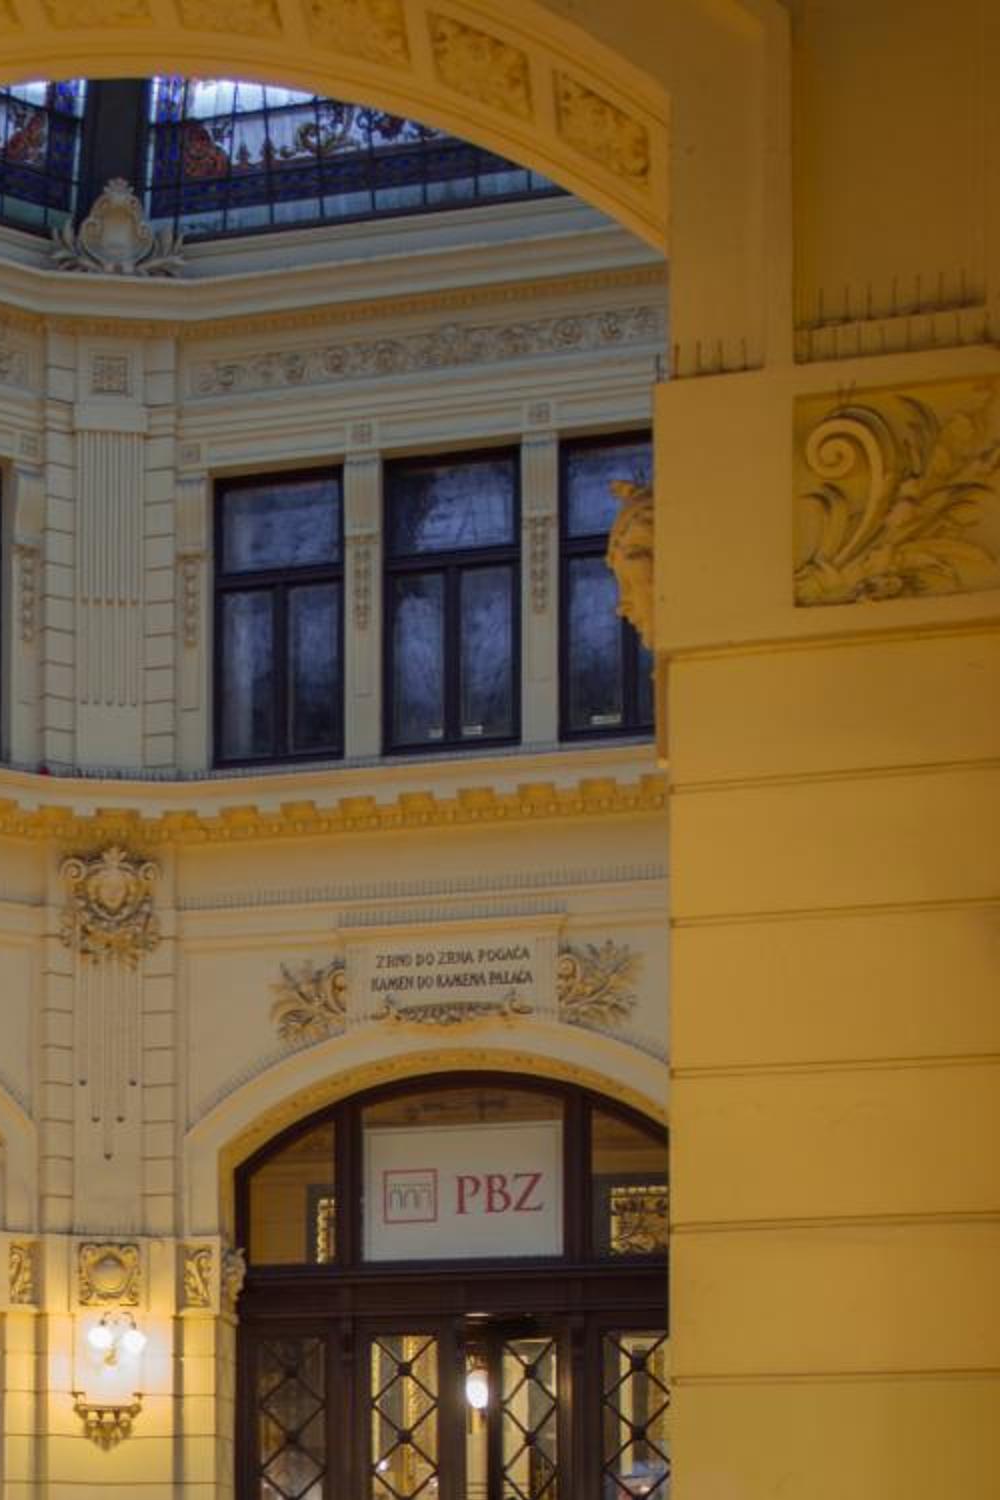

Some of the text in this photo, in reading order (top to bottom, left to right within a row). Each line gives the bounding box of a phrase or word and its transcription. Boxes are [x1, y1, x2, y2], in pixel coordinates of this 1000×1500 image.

[416, 952, 435, 967] DO
[371, 975, 414, 992] KAMEN
[417, 975, 434, 990] DO
[437, 971, 486, 988] KAMENA
[455, 1172, 544, 1215] PBZ
